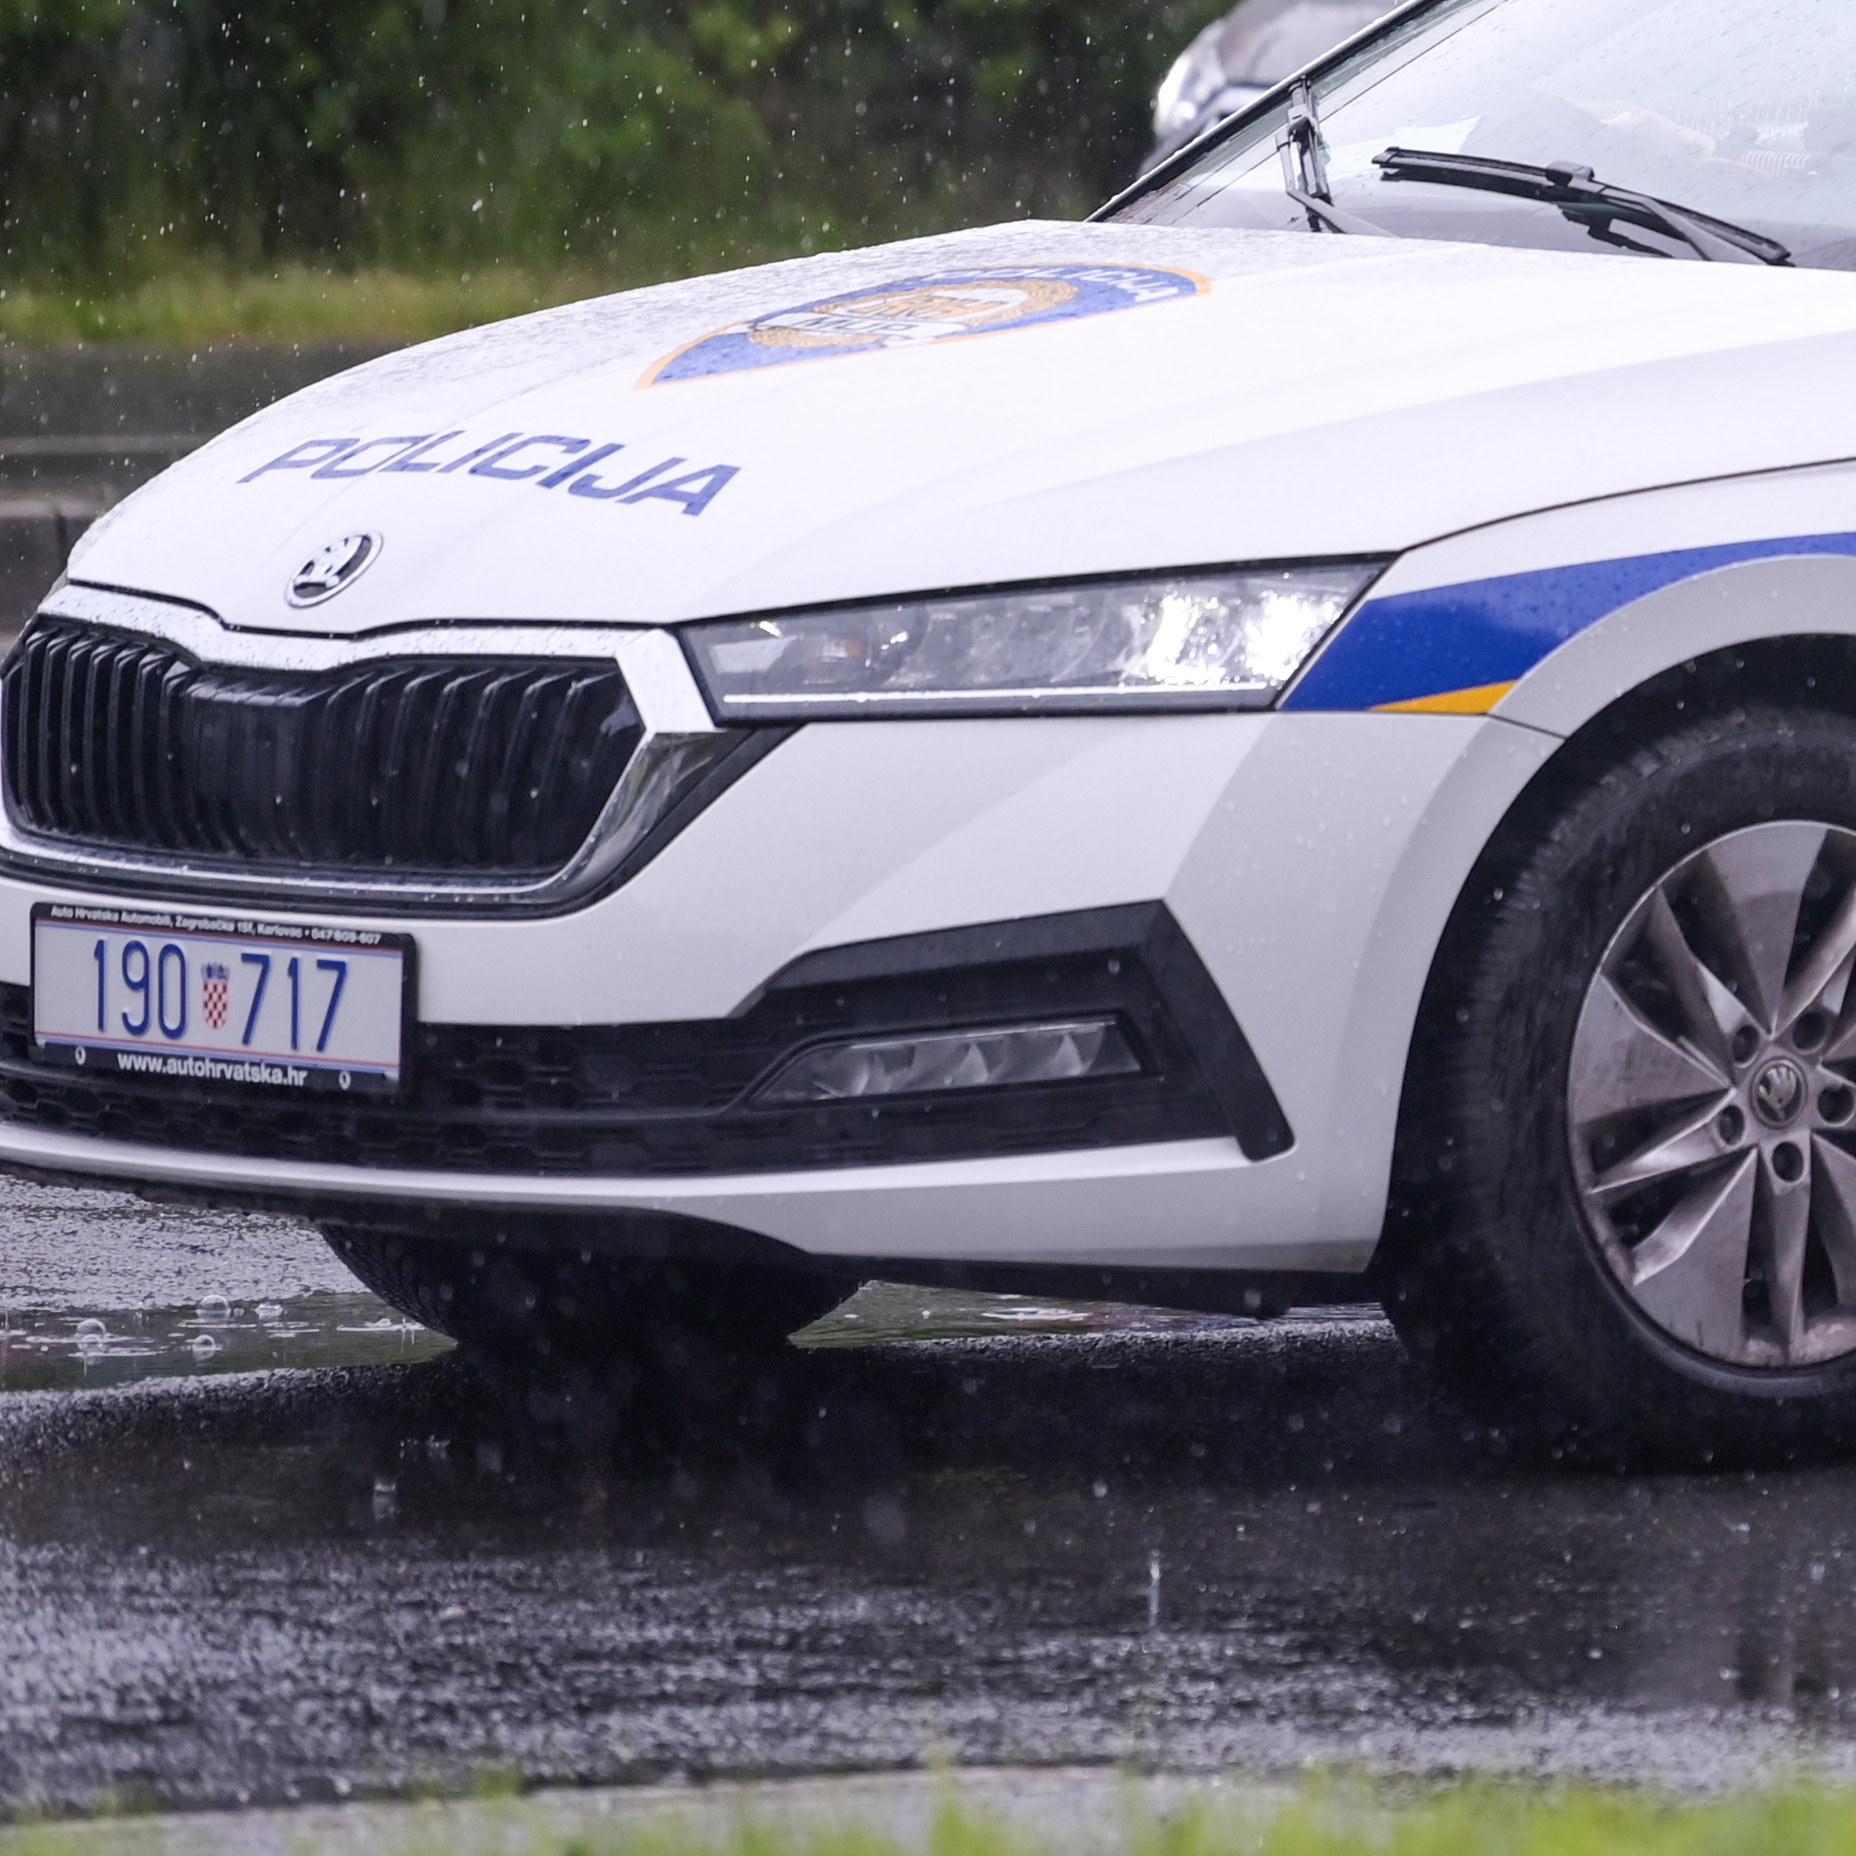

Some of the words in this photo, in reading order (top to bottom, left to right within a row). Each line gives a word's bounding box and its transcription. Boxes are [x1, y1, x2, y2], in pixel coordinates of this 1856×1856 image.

[236, 428, 741, 517] POLICIJA
[94, 938, 187, 1040] 190
[240, 952, 348, 1053] 717
[117, 1052, 308, 1087] www.autohrvatska.hr
